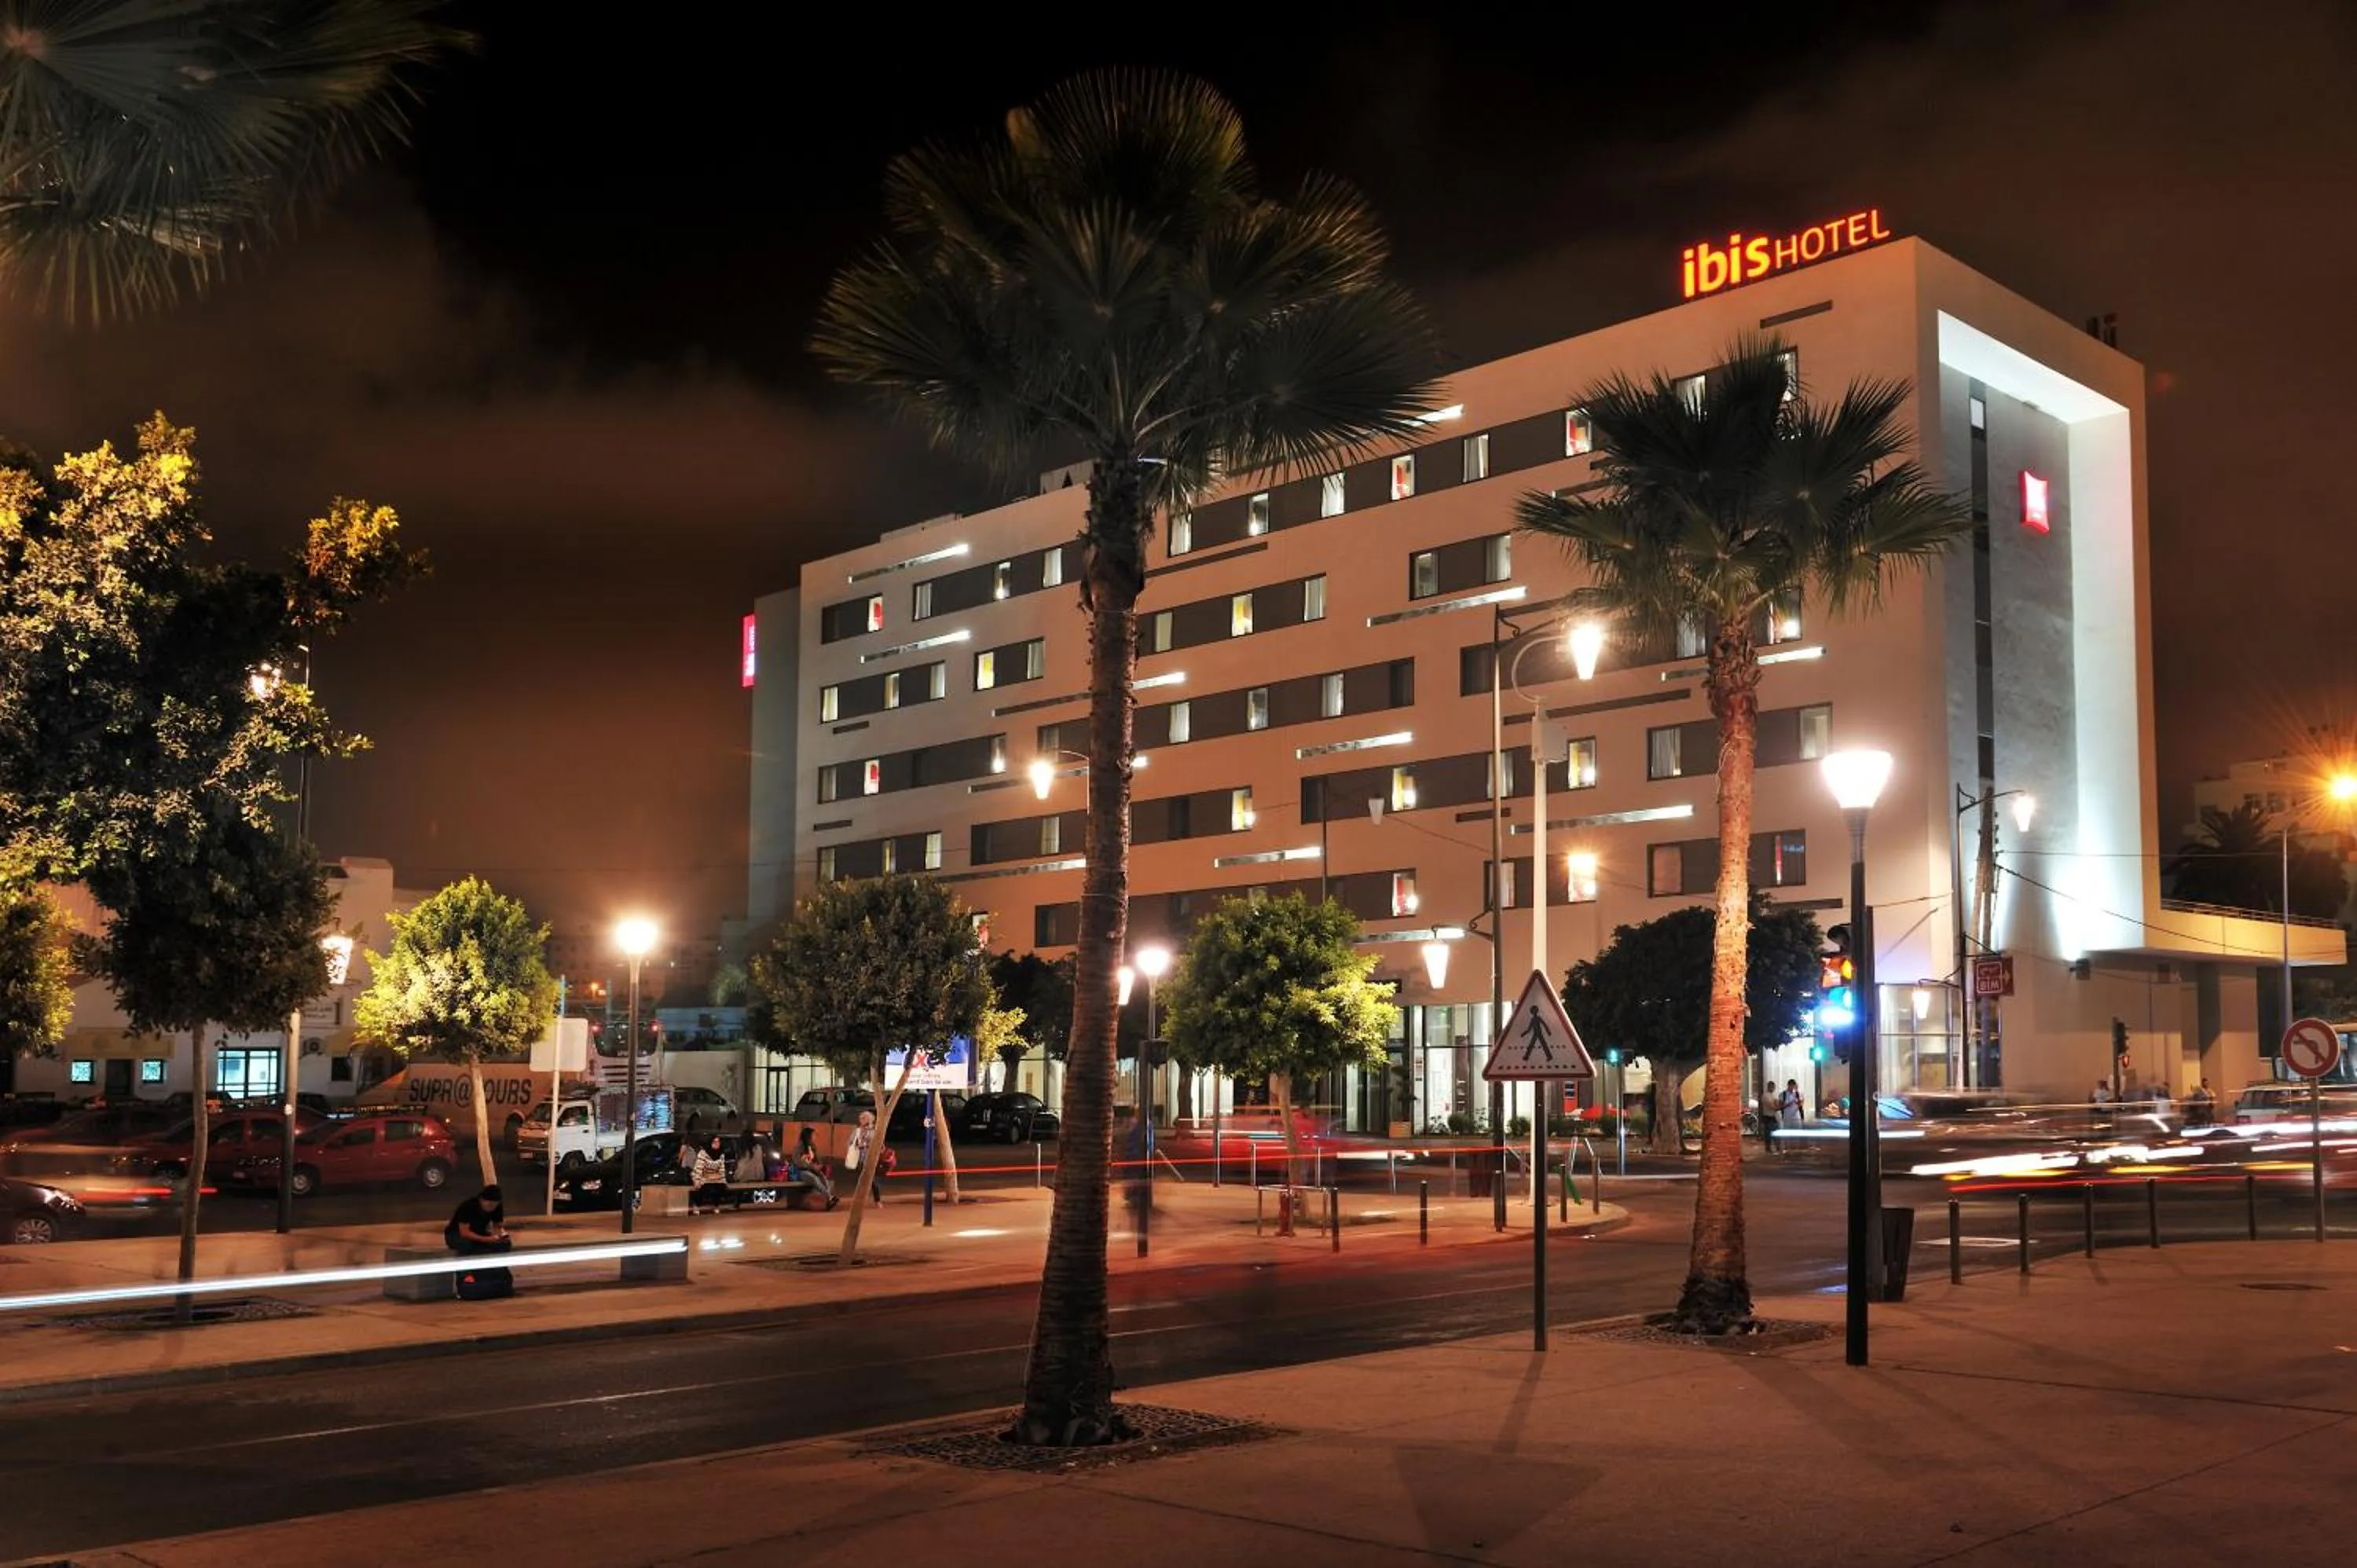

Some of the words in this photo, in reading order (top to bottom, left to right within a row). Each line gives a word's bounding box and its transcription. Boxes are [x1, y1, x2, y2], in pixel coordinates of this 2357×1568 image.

[1683, 233, 1771, 299] ibis
[1774, 208, 1890, 269] HOTEL
[409, 1073, 532, 1108] SUPR@OURS
